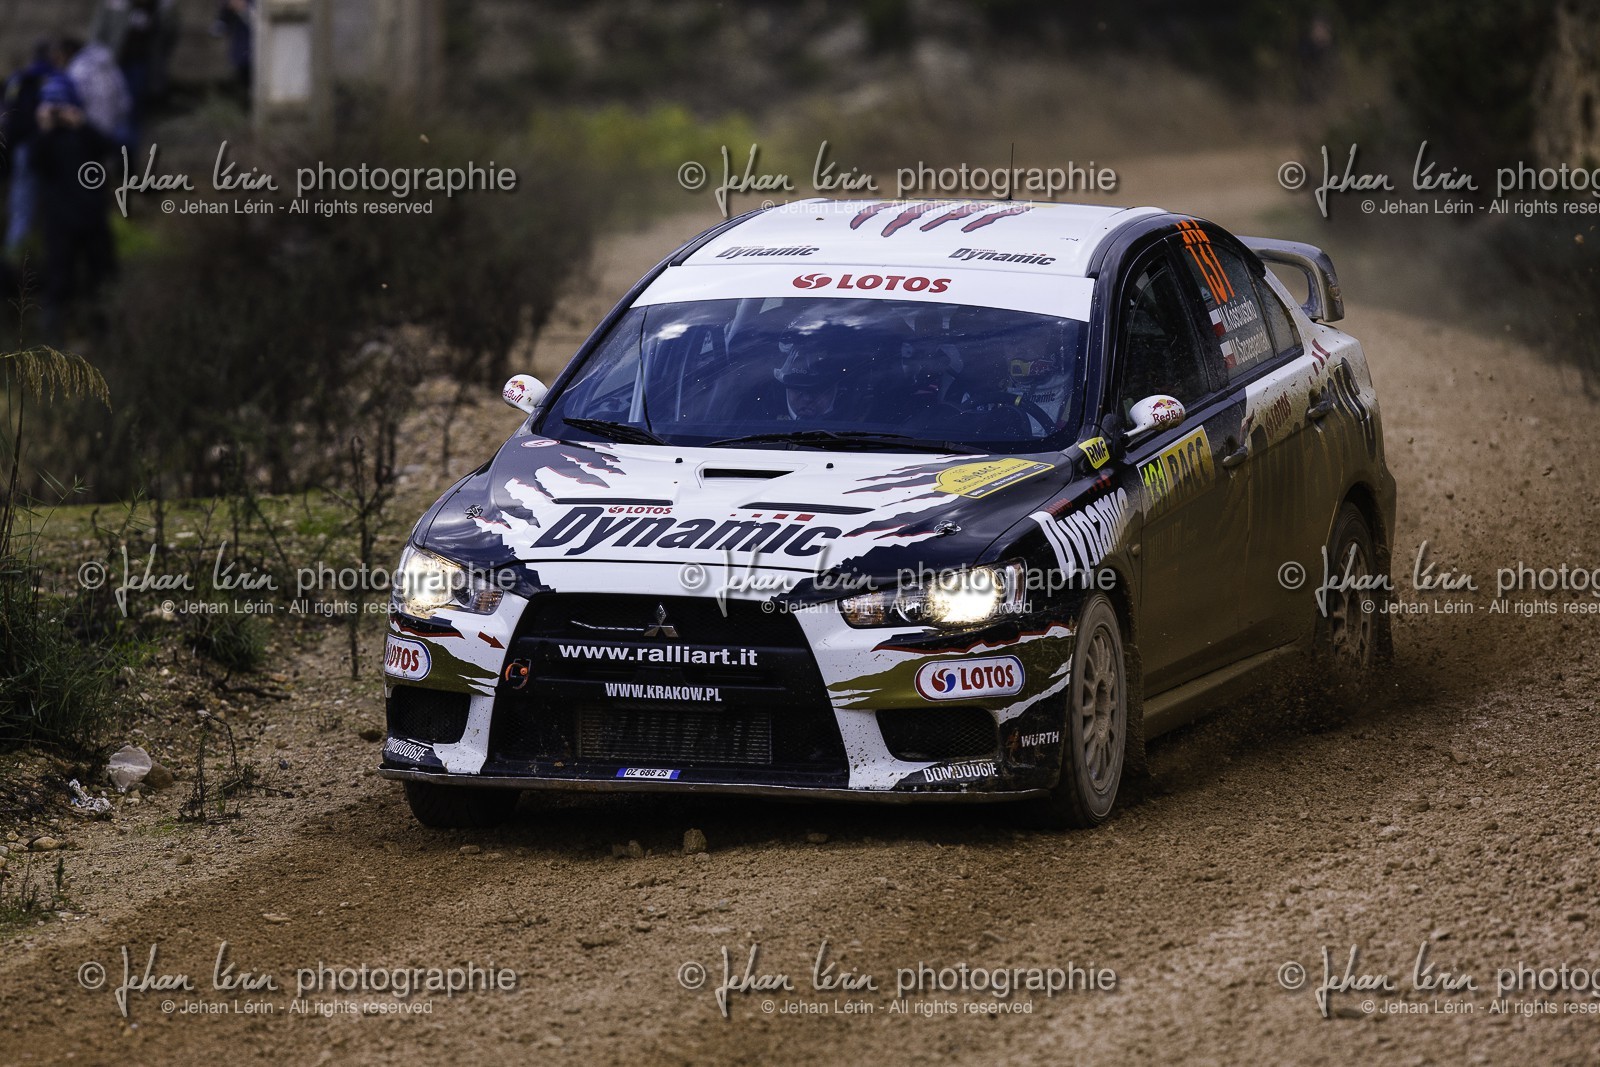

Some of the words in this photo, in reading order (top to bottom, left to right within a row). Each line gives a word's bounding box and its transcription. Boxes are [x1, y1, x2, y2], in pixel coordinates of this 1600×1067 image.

[715, 246, 820, 260] Dynamic
[948, 246, 1056, 263] Dynamic
[837, 274, 951, 293] LOTOS
[1085, 441, 1107, 464] RMF
[626, 506, 673, 514] LOTOS
[529, 507, 843, 556] Dynamic
[1029, 487, 1129, 588] Dynamic
[558, 644, 758, 666] www.ralliart.it
[960, 664, 1015, 691] LOTOS
[605, 682, 722, 702] WWW.KRAKOW.PL
[1021, 730, 1060, 748] WÜRTH
